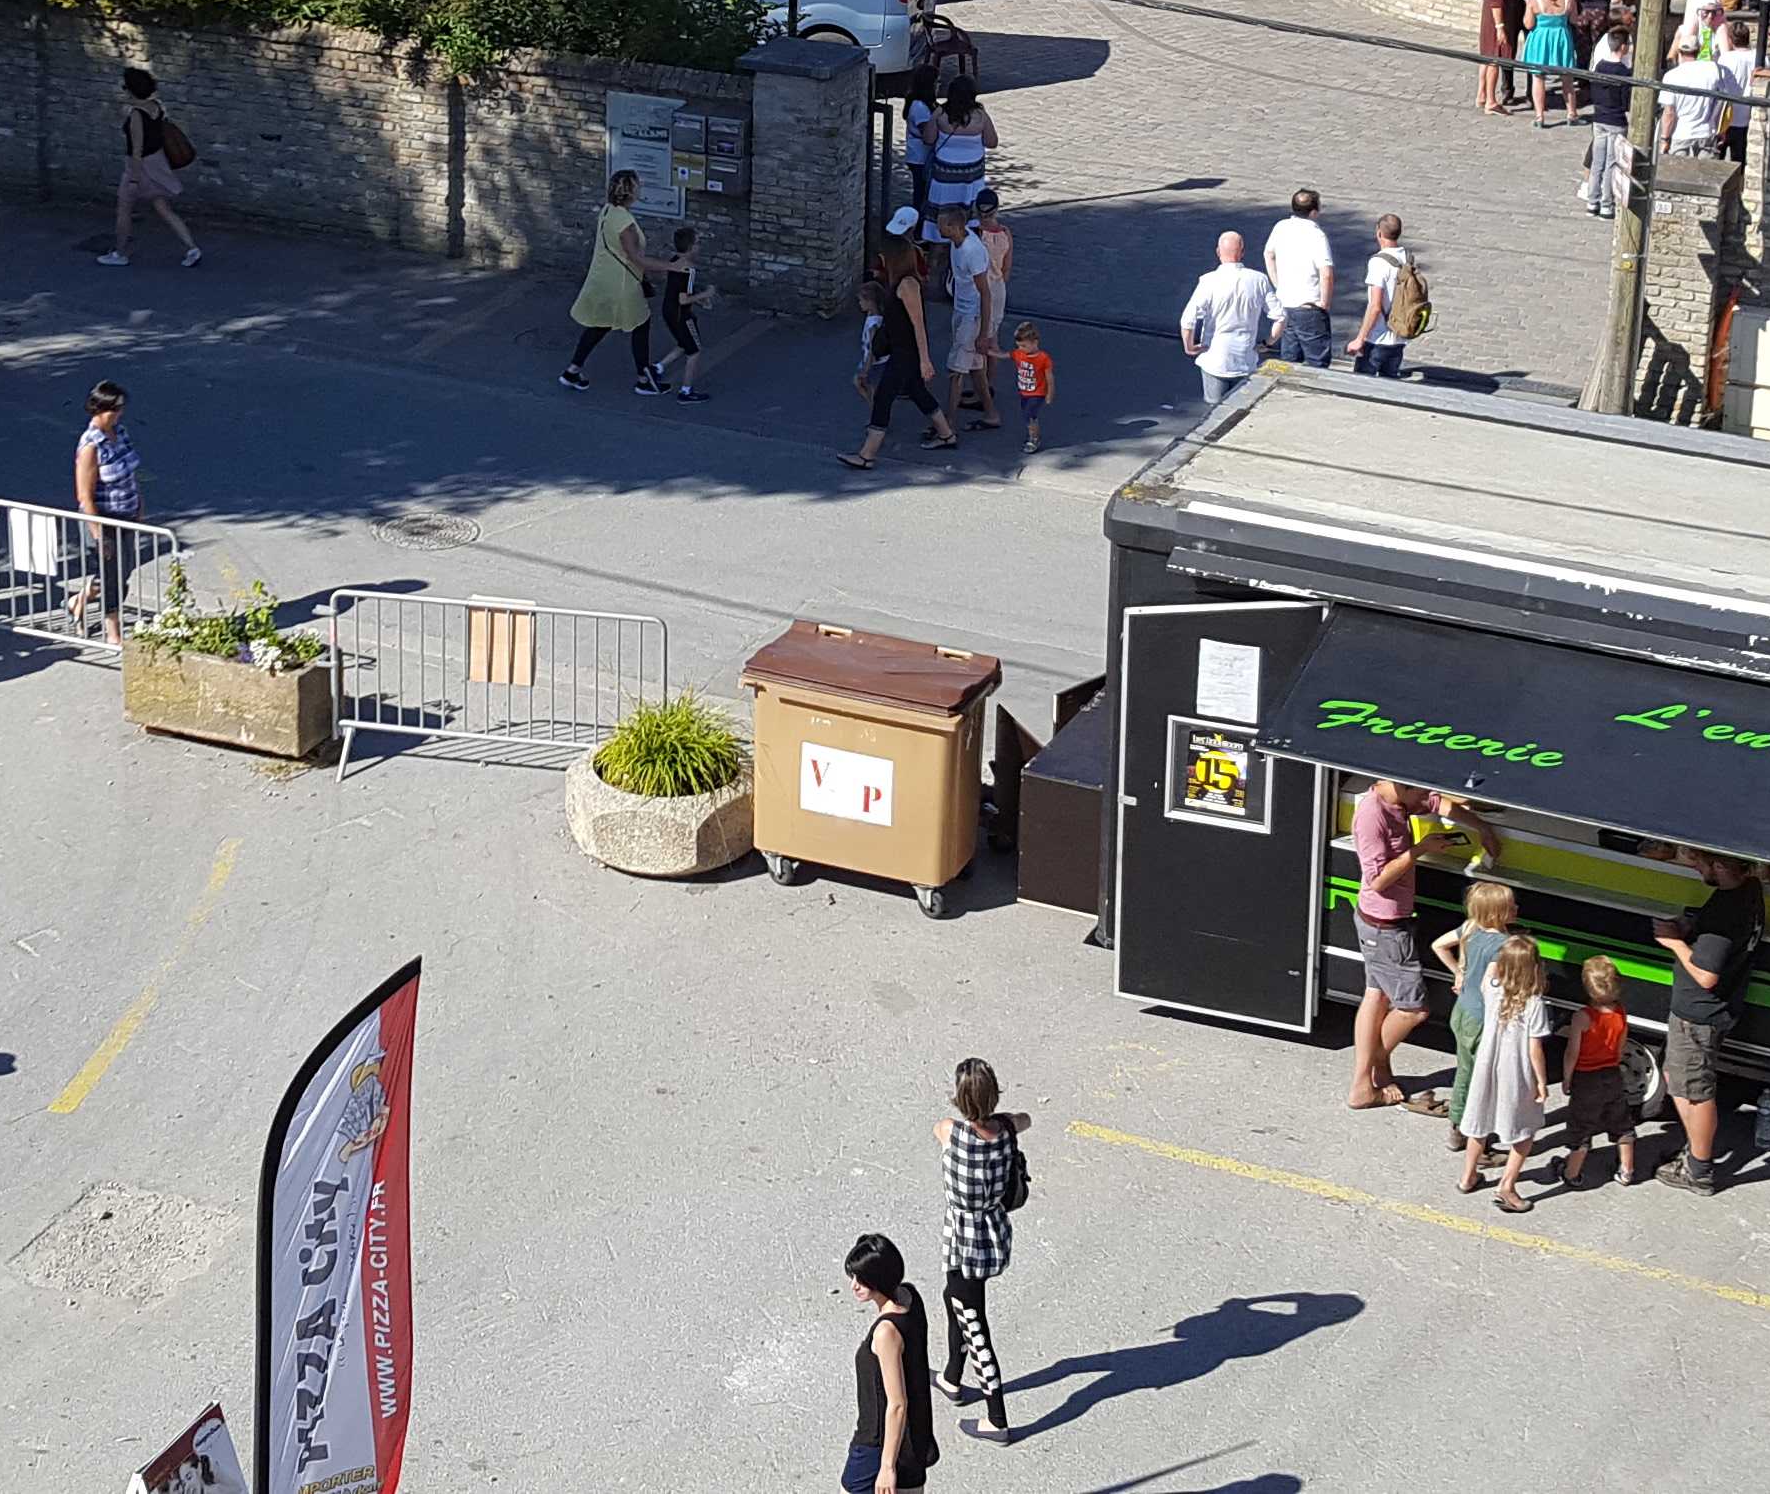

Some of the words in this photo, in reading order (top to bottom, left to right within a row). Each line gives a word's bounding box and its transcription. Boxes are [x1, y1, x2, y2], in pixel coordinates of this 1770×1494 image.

[1316, 700, 1564, 767] Friterie
[810, 758, 831, 787] V
[862, 784, 882, 813] P
[368, 1179, 397, 1420] WWW.PIZZA-CITY.FR
